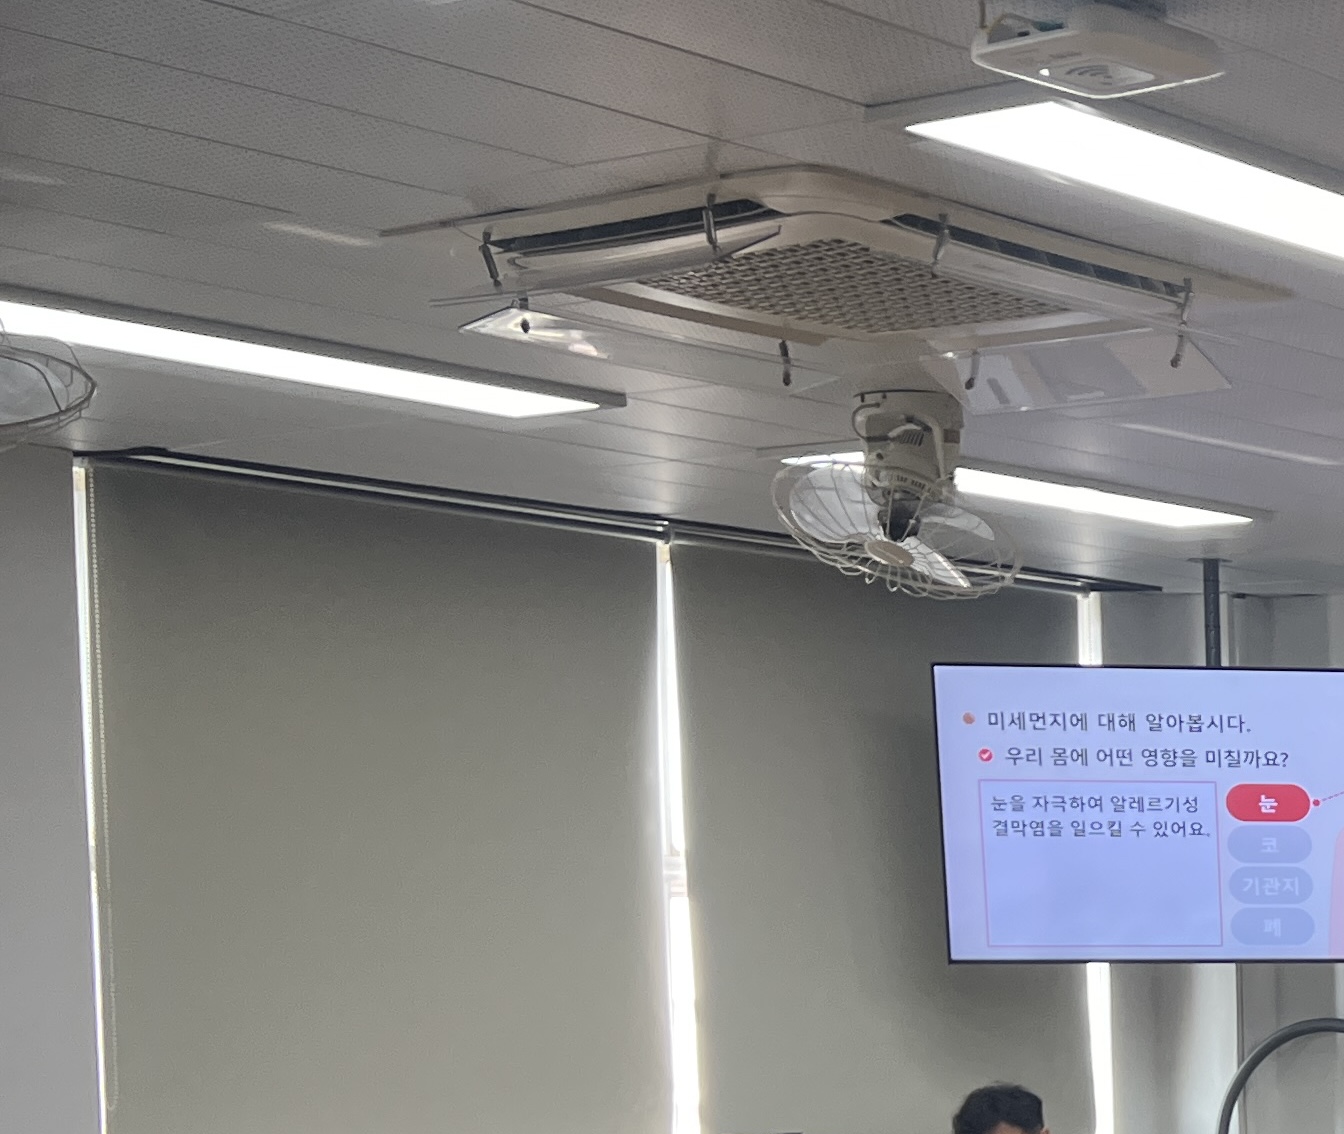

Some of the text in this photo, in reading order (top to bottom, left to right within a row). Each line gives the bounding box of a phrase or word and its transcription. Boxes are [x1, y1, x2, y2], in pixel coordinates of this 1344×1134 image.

[988, 712, 1251, 733] 미세먼지에 대해 알아봅시다.
[1006, 748, 1288, 768] 우리 몸에 어떤 영향을 미칠까요?
[991, 795, 1198, 813] 눈을 자극하여 알레르기성
[1259, 795, 1278, 814] 눈
[993, 820, 1210, 838] 결막염을 일으킬 수 있어요.
[1262, 837, 1278, 854] 코
[1242, 877, 1299, 896] 기관지
